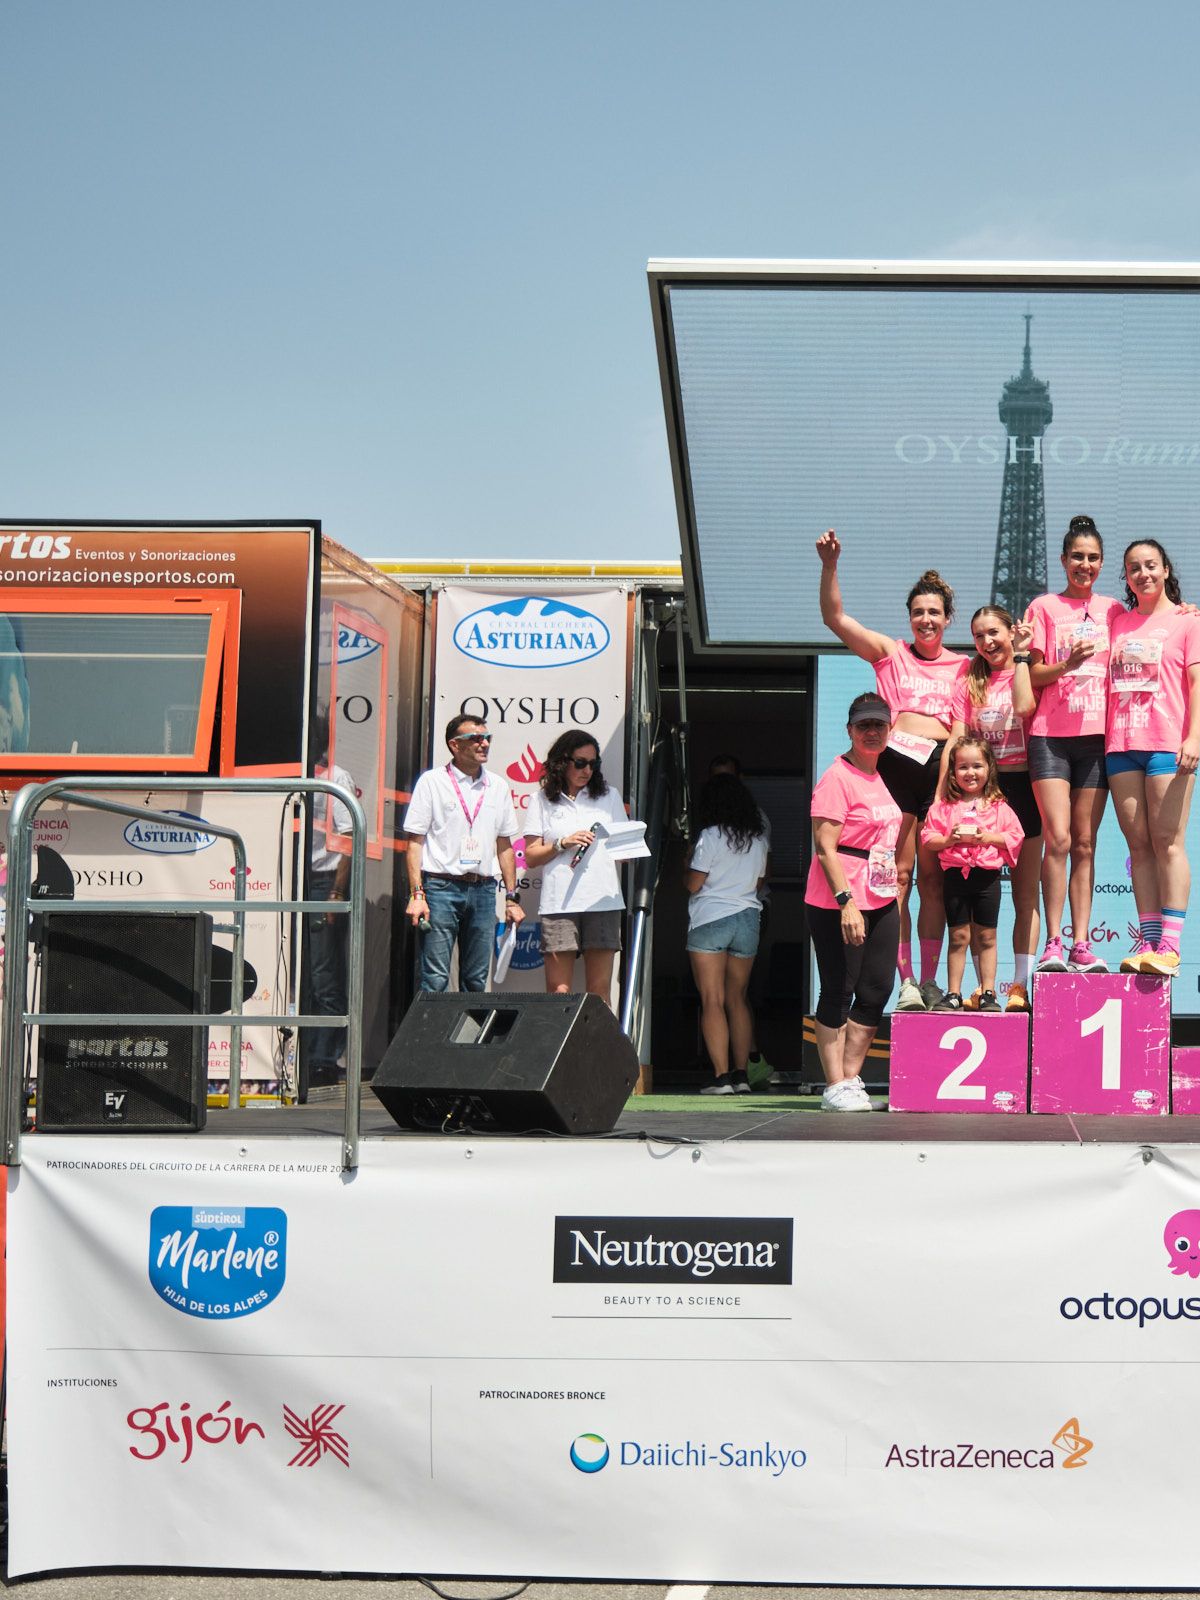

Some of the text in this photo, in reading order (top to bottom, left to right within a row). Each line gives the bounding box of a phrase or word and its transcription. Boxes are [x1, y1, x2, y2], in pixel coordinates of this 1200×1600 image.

[894, 434, 1091, 465] OYSHO
[75, 548, 125, 561] Eventos
[129, 551, 136, 562] y
[140, 548, 236, 562] Sonorizaciones
[0, 566, 235, 585] sonorizacionesportos.com
[465, 622, 599, 650] ASTURIANA
[1123, 663, 1143, 673] 016
[459, 696, 600, 725] OYSHO
[1067, 692, 1105, 714] MUJE
[1113, 709, 1149, 730] MUJER
[983, 730, 1005, 740] 016
[33, 819, 69, 830] ENCIA
[36, 833, 63, 842] JUNIO
[209, 879, 272, 891] Santnder
[1080, 998, 1123, 1090] 1
[936, 1025, 988, 1100] 2
[105, 1092, 126, 1111] EV
[46, 1160, 128, 1171] PATROCINADORES
[129, 1161, 147, 1171] DEL
[149, 1161, 193, 1172] CIRCUITO
[195, 1162, 208, 1172] DE
[209, 1163, 221, 1172] LA
[223, 1163, 266, 1173] CARRERA
[268, 1164, 281, 1173] DE
[282, 1164, 295, 1173] LA
[297, 1164, 328, 1173] MUJER
[163, 1285, 269, 1315] HIJA DE LOS ALPES
[603, 1295, 742, 1307] BEAUTY TO A SCIENCE
[46, 1378, 118, 1388] INSTITUCIONES
[478, 1389, 607, 1401] PATROCINADORES BRONCE
[126, 1400, 266, 1464] gijón
[620, 1441, 807, 1477] Daiichi-Sankyo
[884, 1443, 1055, 1470] AstraZeneca
